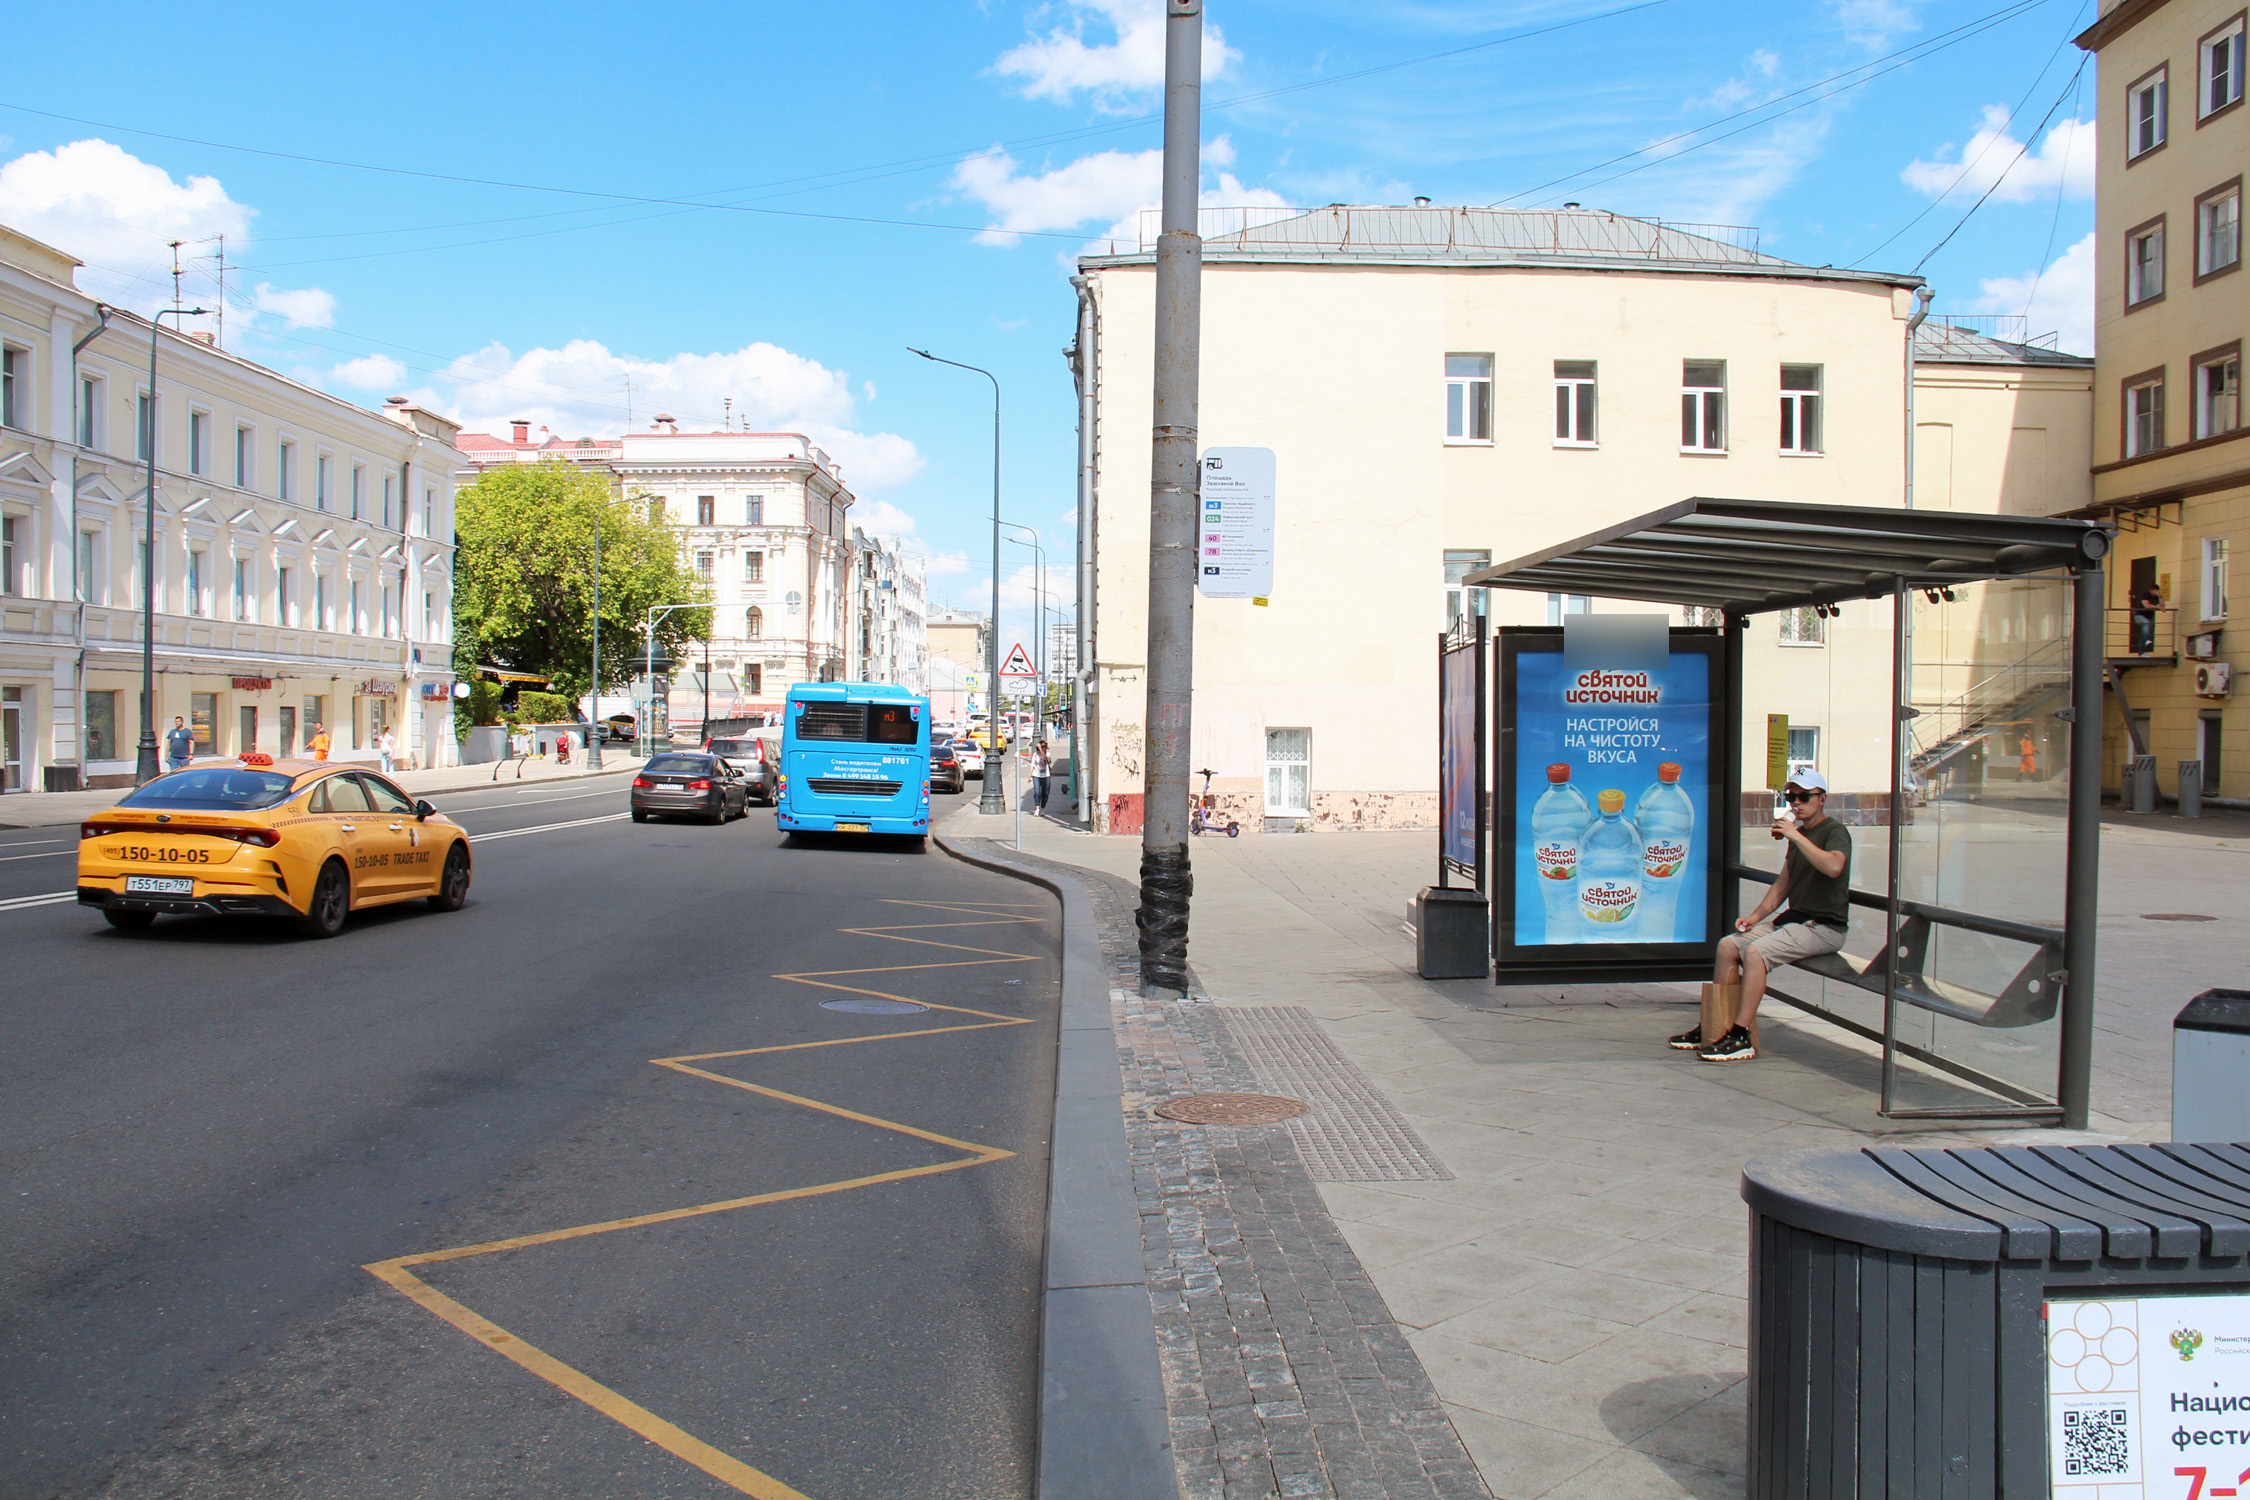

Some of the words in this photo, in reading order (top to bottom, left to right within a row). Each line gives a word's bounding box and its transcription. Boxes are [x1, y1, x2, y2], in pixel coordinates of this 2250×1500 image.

[233, 678, 272, 690] ПРОДУКТЫ
[372, 678, 398, 695] Шаурма
[1566, 716, 1658, 732] НАСТРОЙСЯ
[1564, 734, 1586, 747] НА
[1590, 734, 1660, 747] ЧИСТОТУ
[882, 756, 910, 765] 081761
[1588, 750, 1637, 763] ВКУСА
[104, 847, 120, 855] (495)
[120, 846, 209, 862] 150-10-05
[354, 854, 388, 869] 150-10-05
[394, 852, 414, 865] TRADE
[415, 851, 430, 863] TAXI
[174, 880, 190, 889] 797
